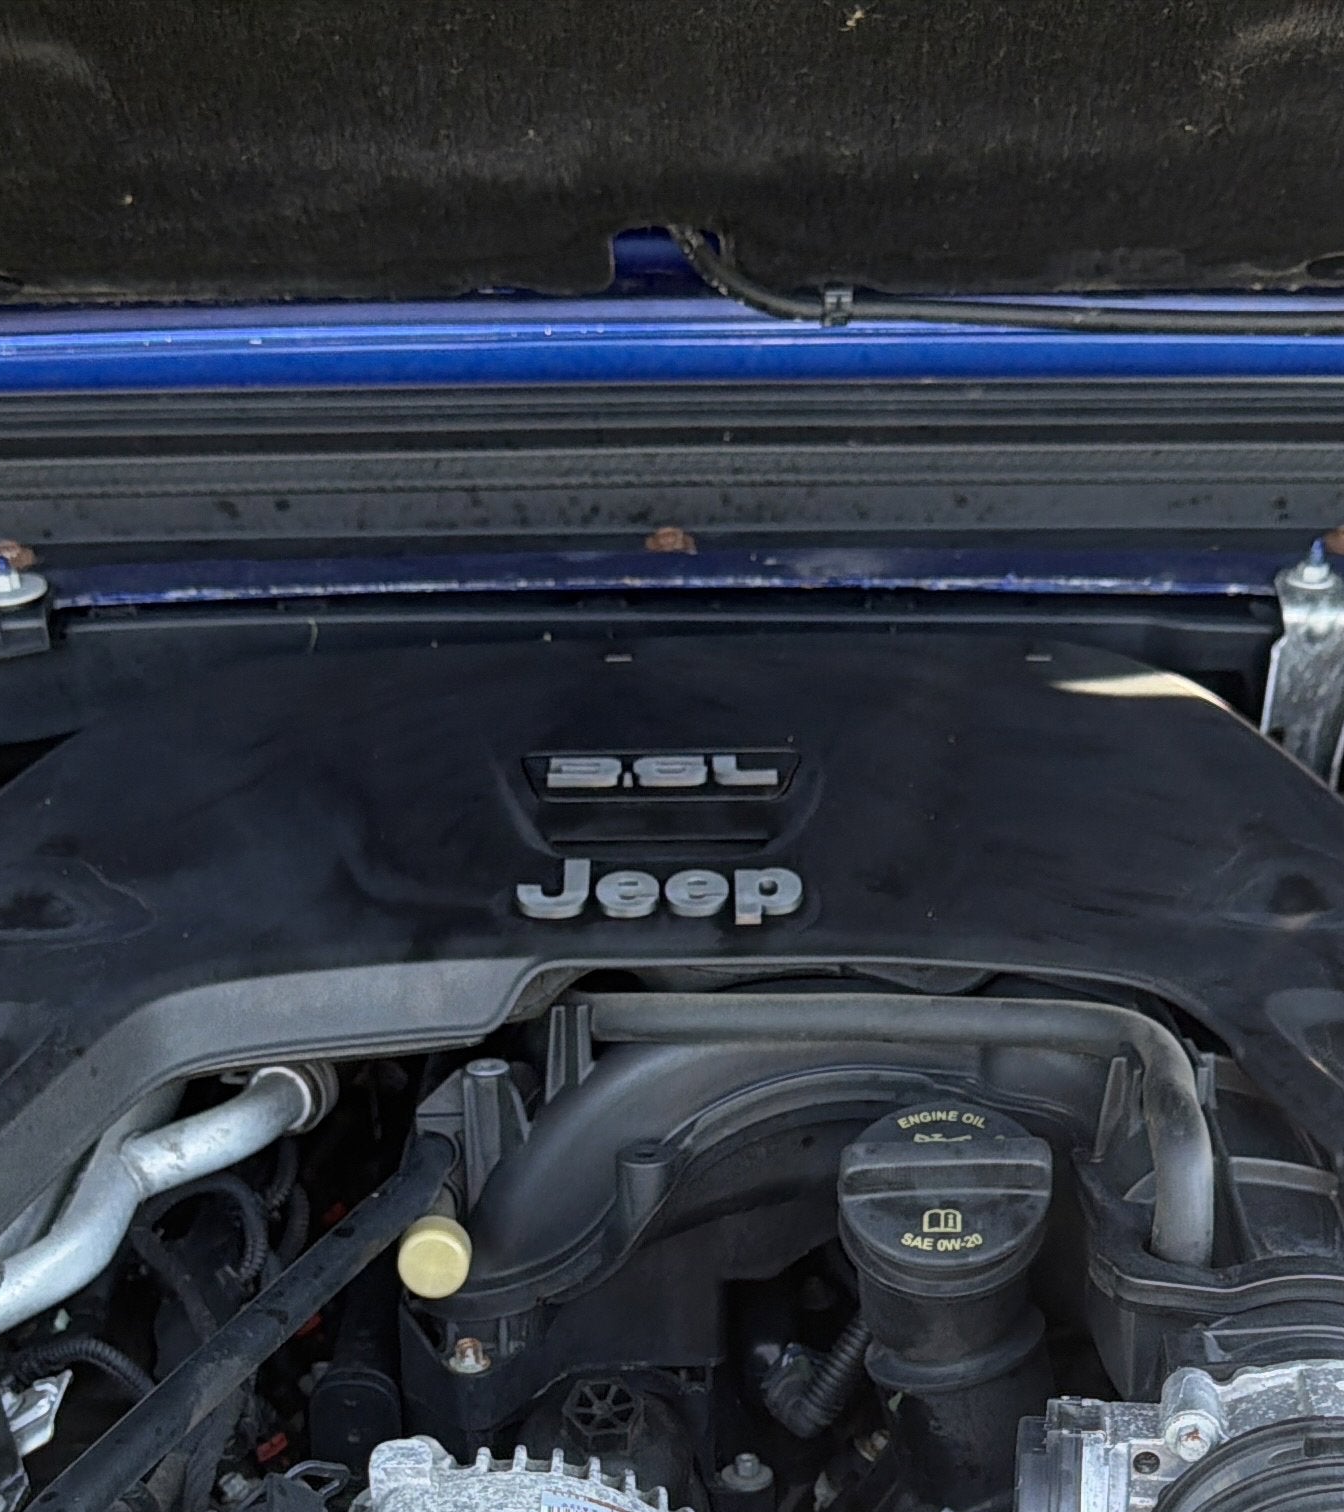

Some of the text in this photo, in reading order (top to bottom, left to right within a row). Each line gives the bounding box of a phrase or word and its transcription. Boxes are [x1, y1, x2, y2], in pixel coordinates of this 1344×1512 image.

[546, 755, 778, 788] 3.6L
[517, 858, 802, 925] Jeep
[897, 1110, 986, 1129] ENGINE OIL
[900, 1233, 983, 1252] SAE 0W-20
